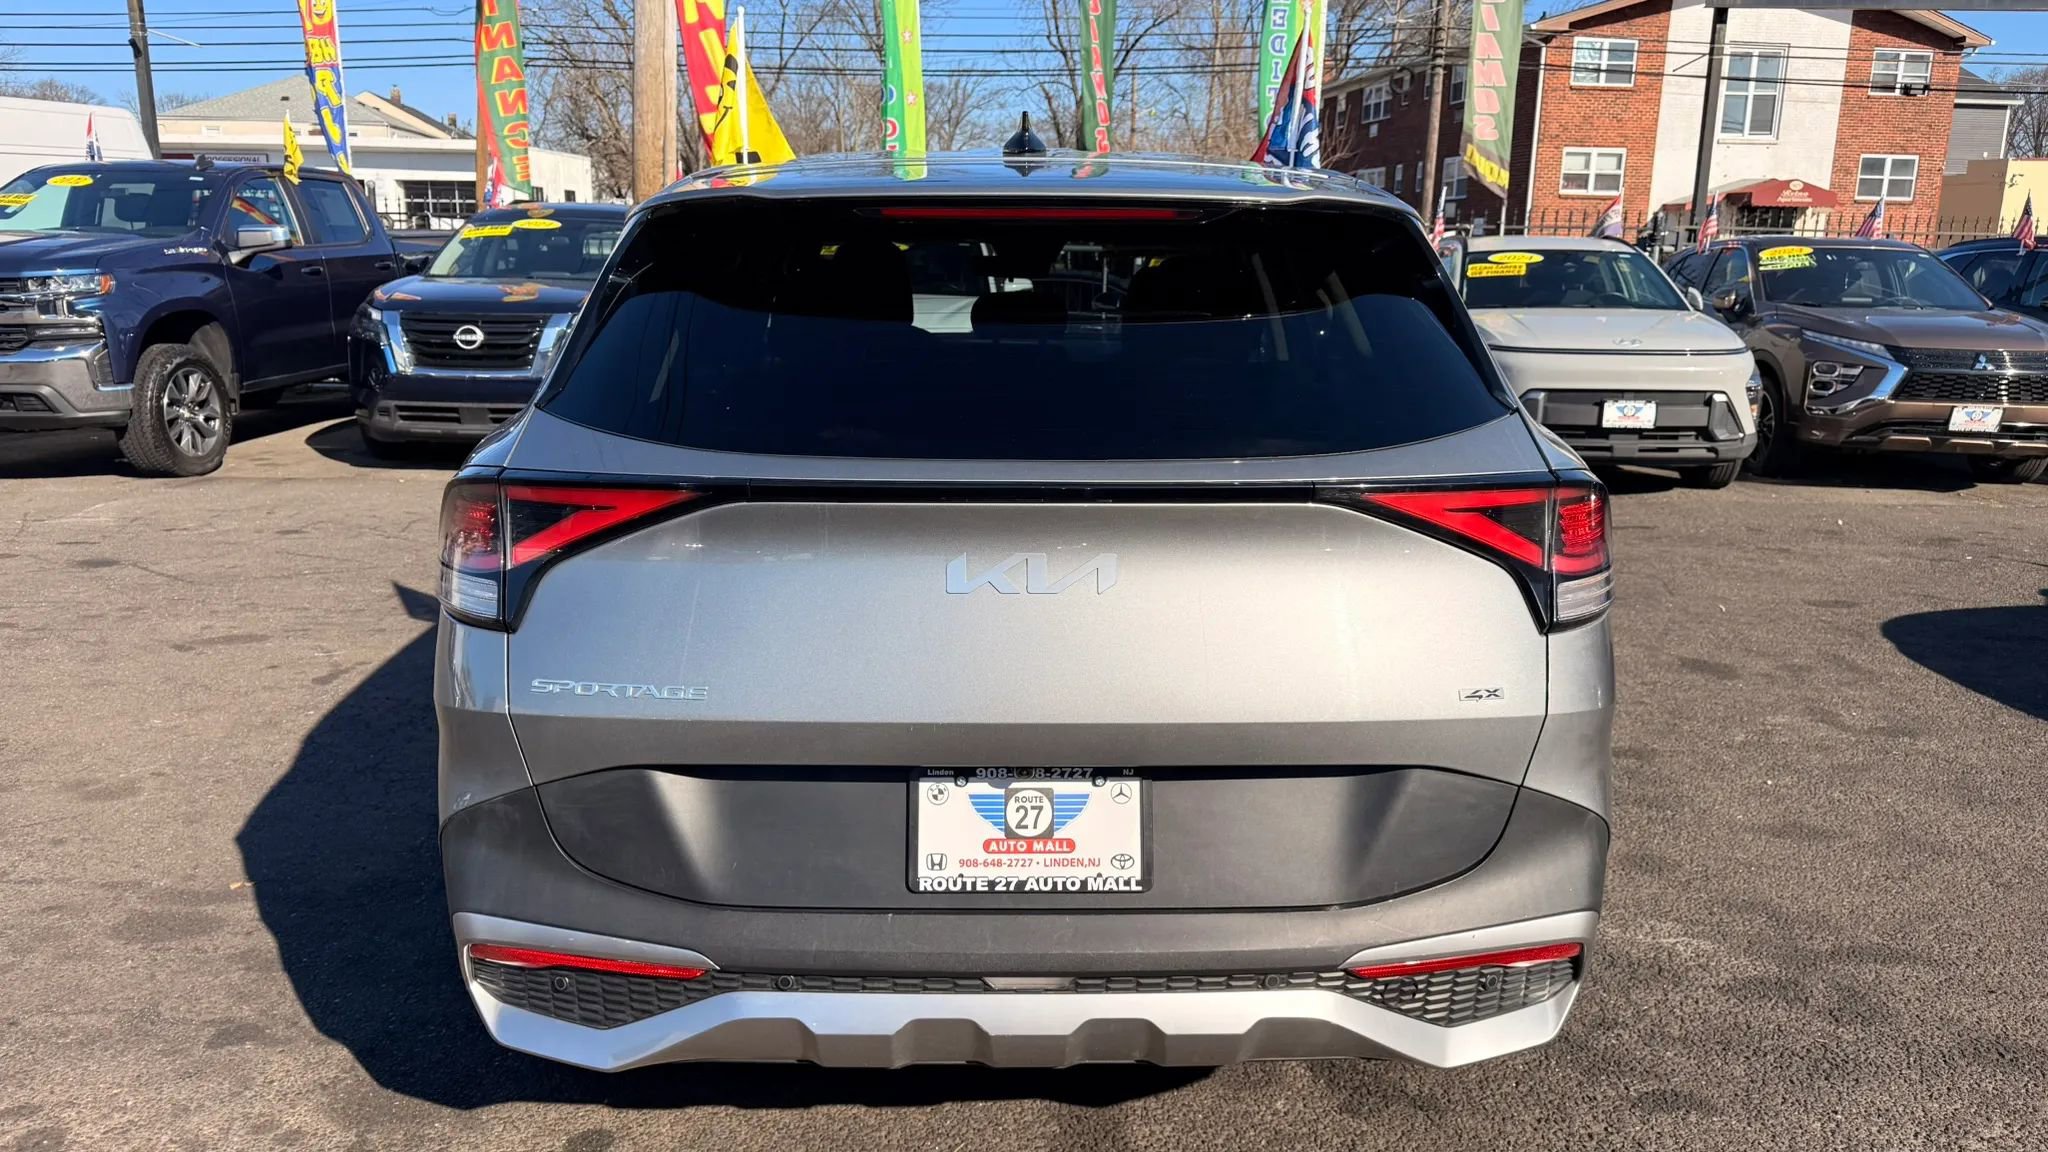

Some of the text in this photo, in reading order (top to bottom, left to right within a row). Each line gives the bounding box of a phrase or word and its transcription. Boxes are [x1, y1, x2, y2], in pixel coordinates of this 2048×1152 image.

[530, 678, 709, 700] SPORTAGE
[928, 767, 1134, 780] Linden 908-8-2727 NJ
[1014, 796, 1044, 804] ROUTE
[1014, 805, 1044, 830] 27
[988, 840, 1071, 852] AUTO MALL
[959, 857, 1101, 868] 908-648-2727 LINDEN,NJ
[919, 877, 1143, 891] ROUTE 27 AUTO MALL
